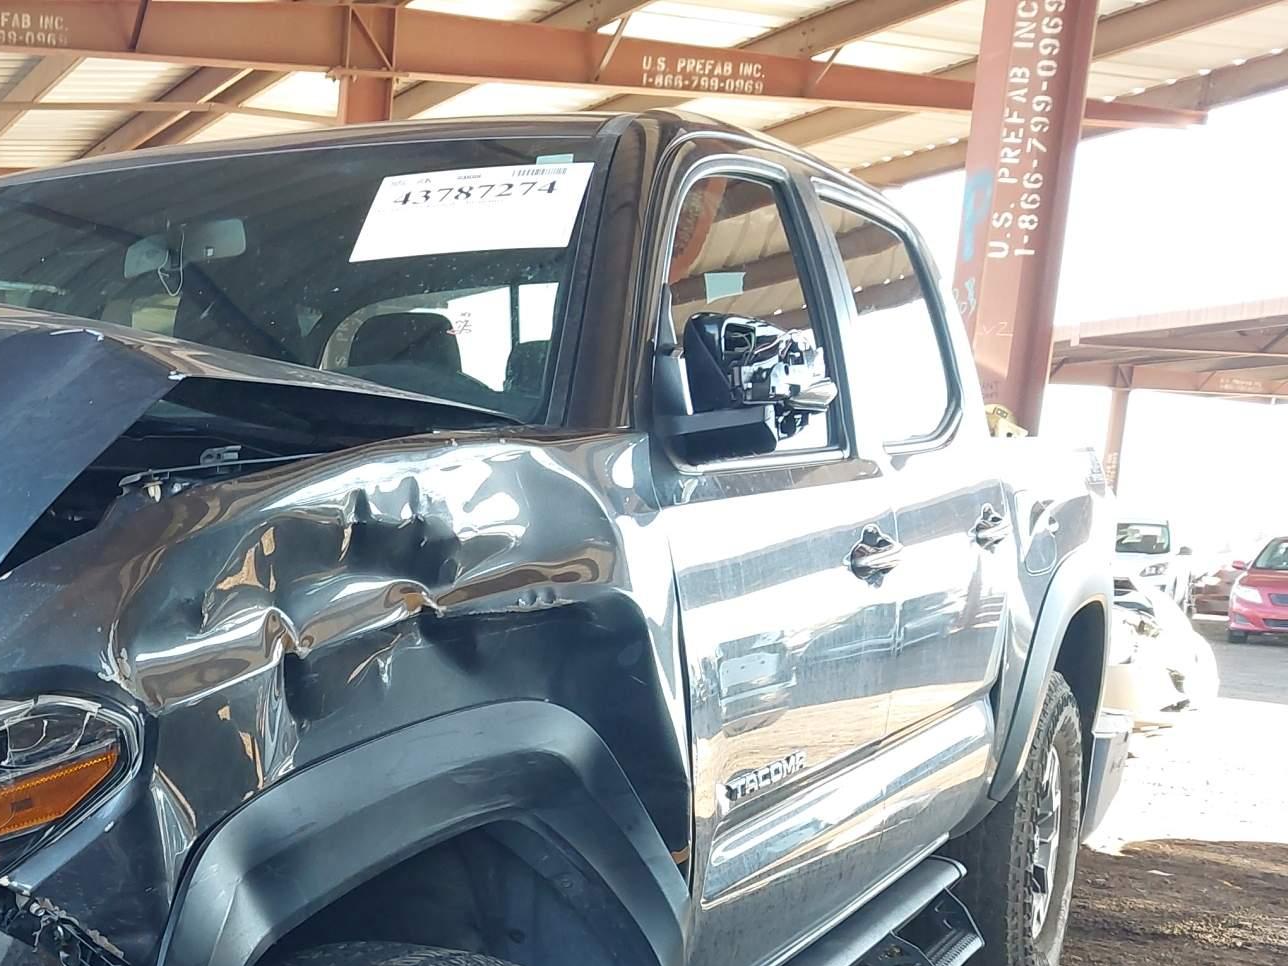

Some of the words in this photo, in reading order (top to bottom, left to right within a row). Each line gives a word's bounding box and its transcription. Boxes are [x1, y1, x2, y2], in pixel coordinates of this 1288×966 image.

[642, 55, 669, 72] U.S.
[677, 58, 733, 76] PREFAB
[739, 62, 765, 79] INC.
[642, 72, 764, 94] 1-866-799-0969
[997, 66, 1030, 184] PREFAB
[393, 180, 557, 206] 43787274
[987, 202, 1015, 259] U.S.
[728, 750, 808, 799] TACOMA
